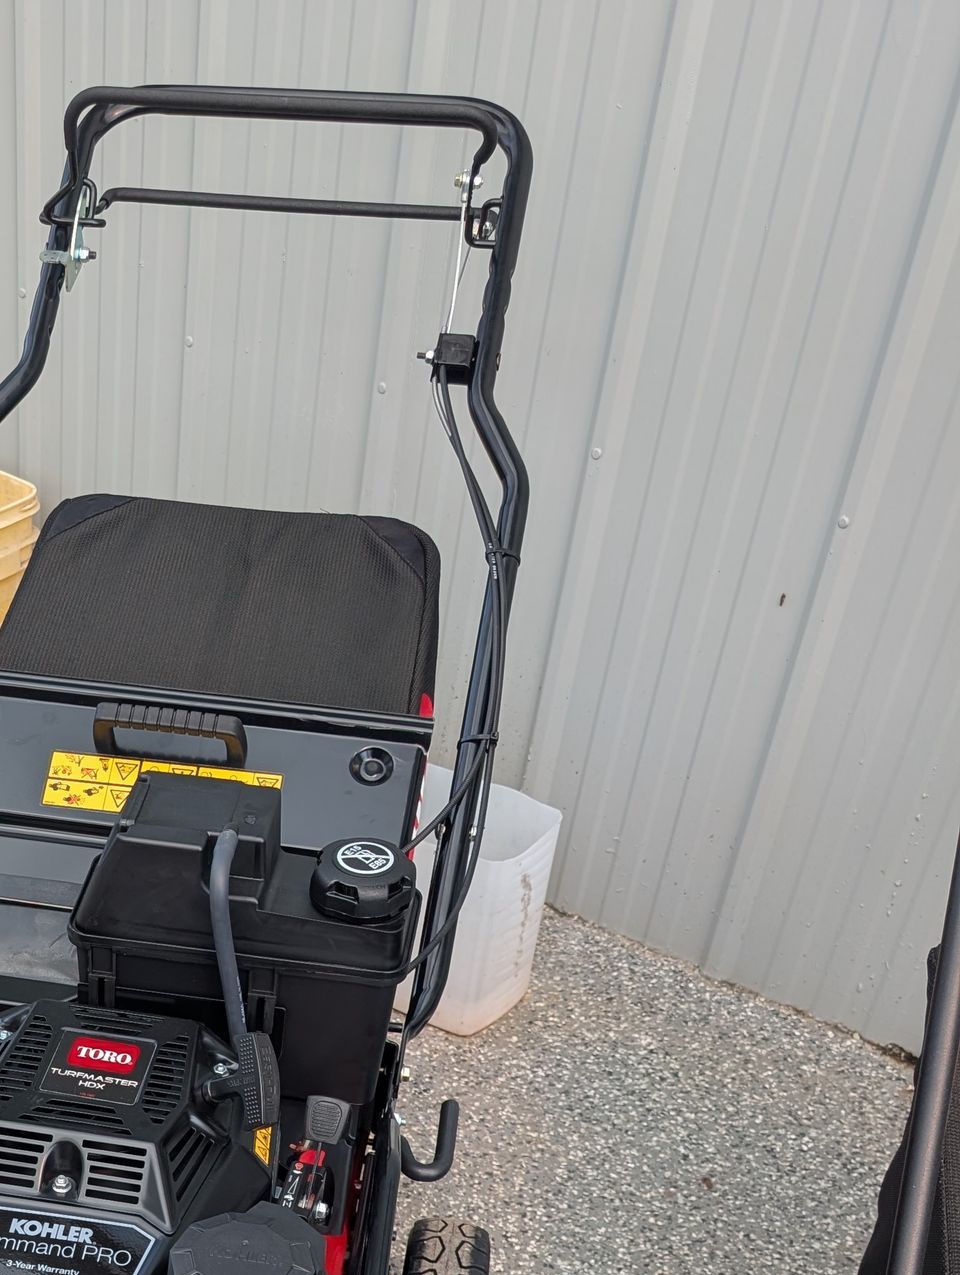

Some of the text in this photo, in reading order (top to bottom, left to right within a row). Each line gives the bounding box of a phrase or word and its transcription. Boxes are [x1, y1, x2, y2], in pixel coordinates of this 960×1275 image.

[344, 845, 362, 856] E15
[368, 858, 386, 870] E85
[76, 1045, 133, 1065] TORO
[50, 1067, 139, 1088] TURFMASTER
[78, 1080, 107, 1090] HDX
[9, 1218, 95, 1244] KOHLER
[81, 1243, 132, 1267] PRO
[6, 1259, 36, 1271] 3-Year
